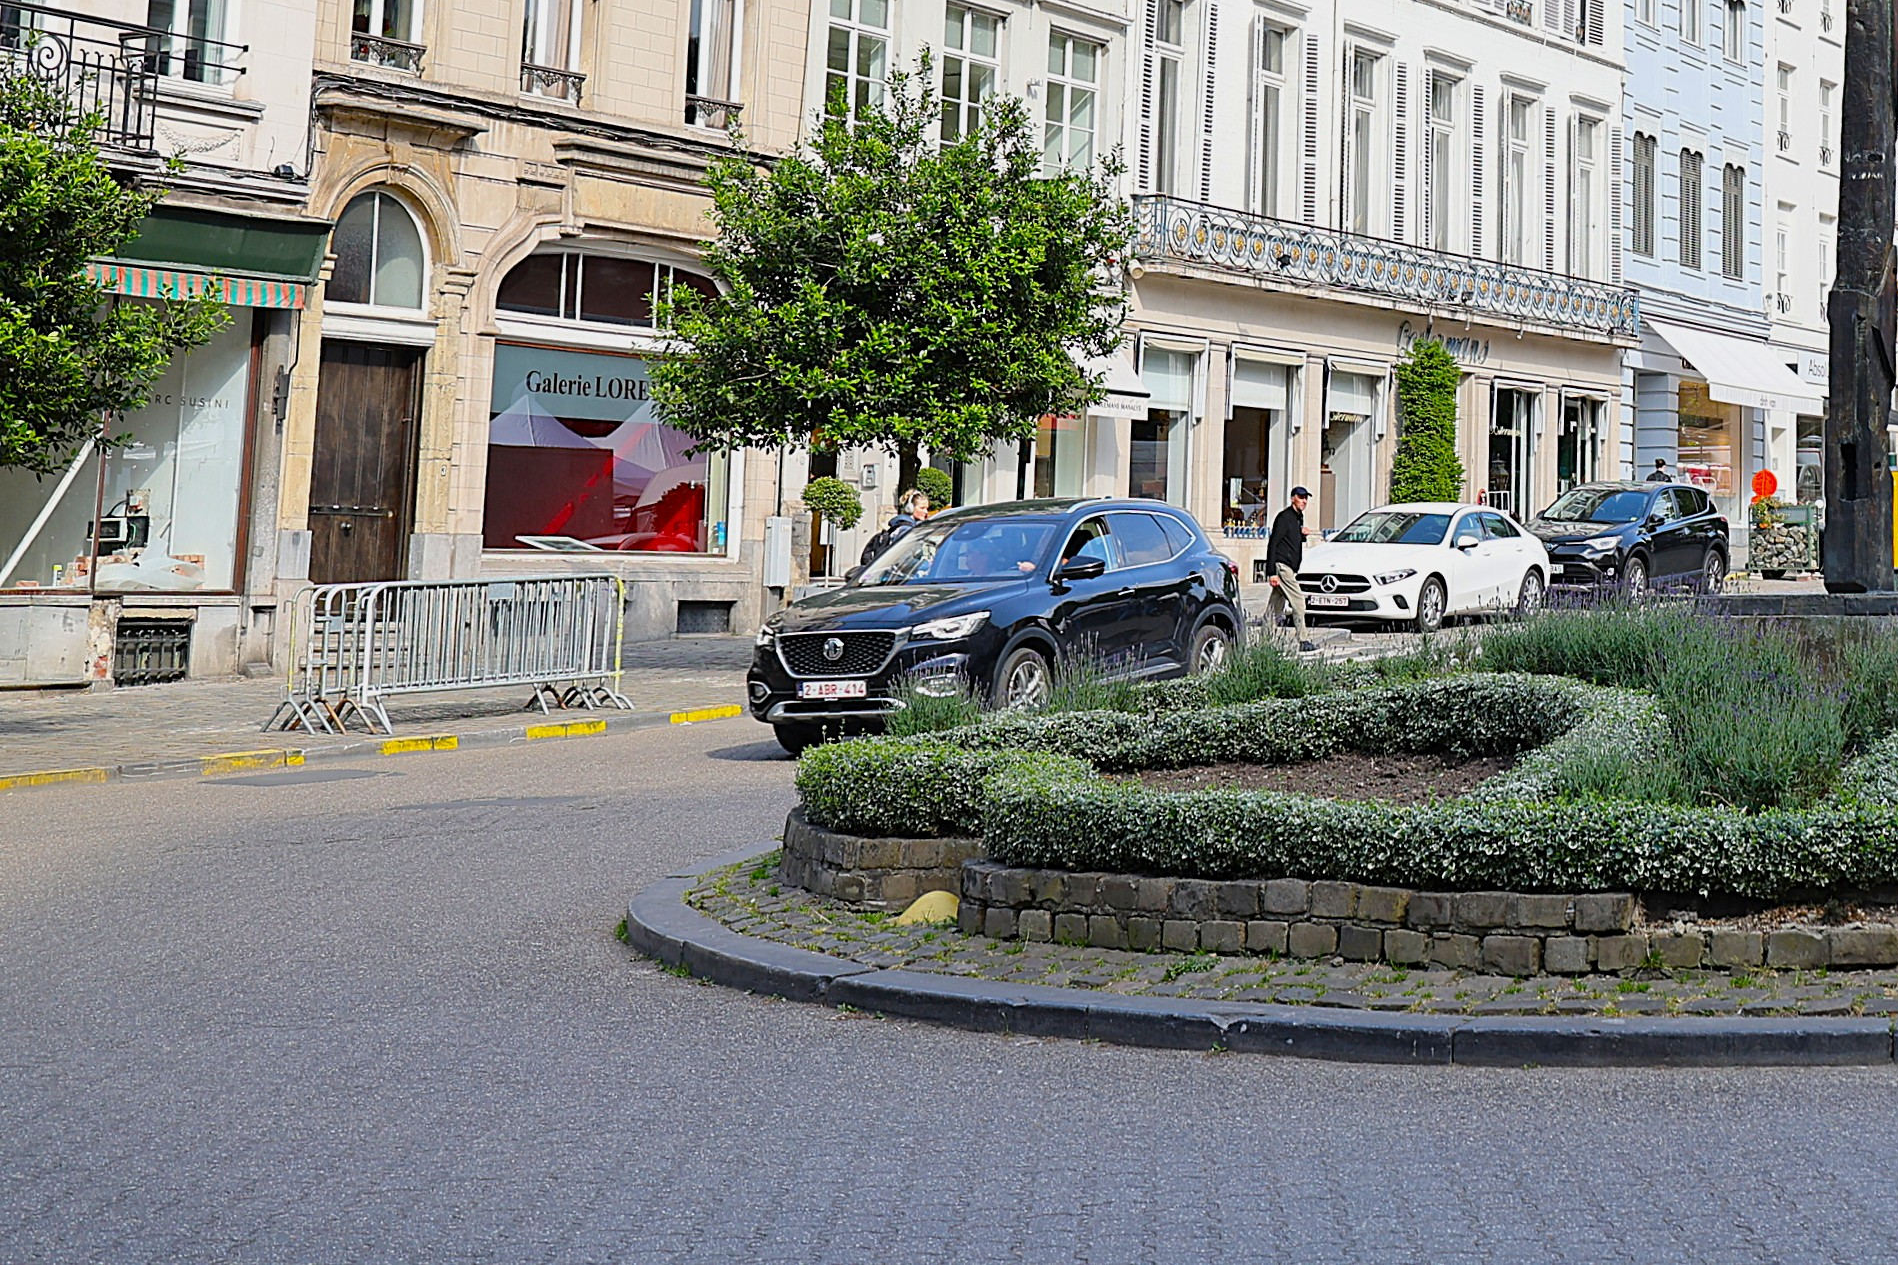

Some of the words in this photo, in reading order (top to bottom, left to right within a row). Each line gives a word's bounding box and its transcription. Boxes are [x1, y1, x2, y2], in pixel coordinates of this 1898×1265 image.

[526, 370, 592, 396] Galerie
[595, 376, 649, 401] LORE
[180, 396, 229, 409] SUSINI
[804, 683, 864, 696] 2-ABR-414
